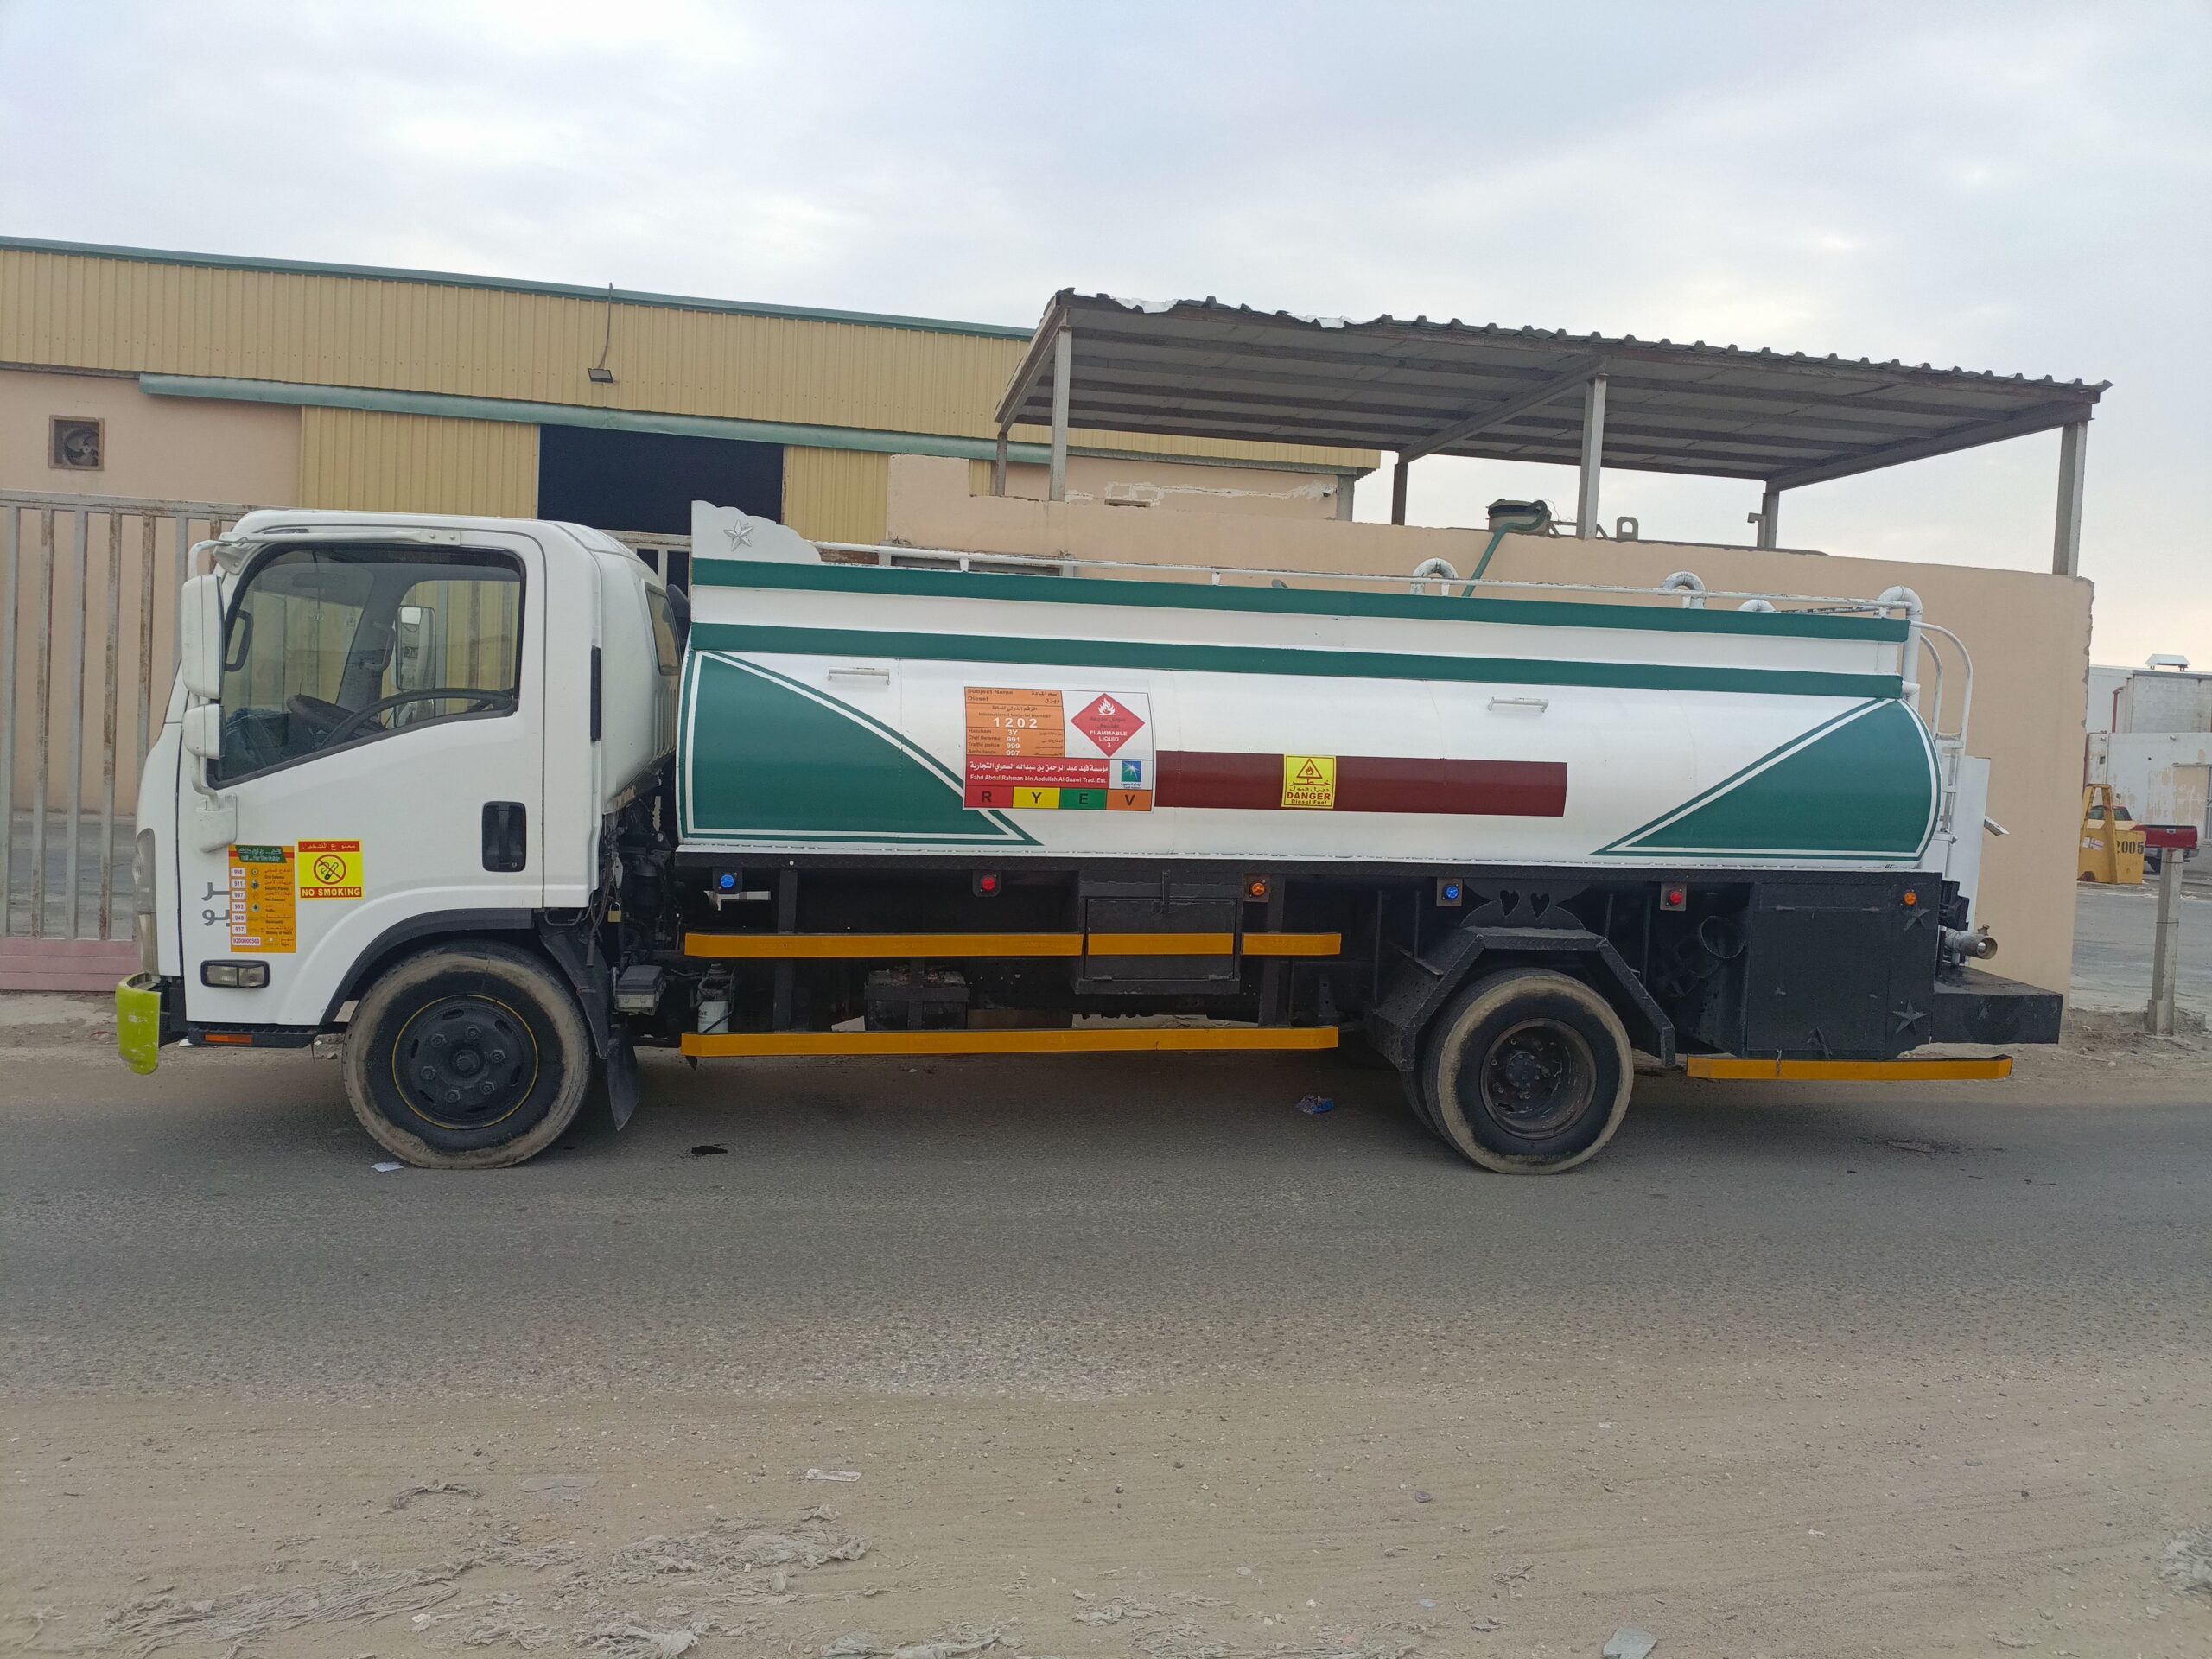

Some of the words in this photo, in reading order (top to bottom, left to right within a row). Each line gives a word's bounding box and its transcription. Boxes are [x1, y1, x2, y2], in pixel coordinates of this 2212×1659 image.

[993, 717, 1038, 728] 1202
[969, 761, 995, 771] التجارية
[1037, 764, 1045, 772] بن
[1078, 764, 1090, 772] فهد
[1090, 764, 1109, 773] مؤسسة
[982, 791, 993, 803] R
[1032, 791, 1042, 804] Y
[1078, 793, 1089, 804] E
[1124, 794, 1135, 806] V
[1287, 791, 1331, 800] DANGER
[302, 888, 315, 897] NO
[317, 887, 360, 897] SMOKING
